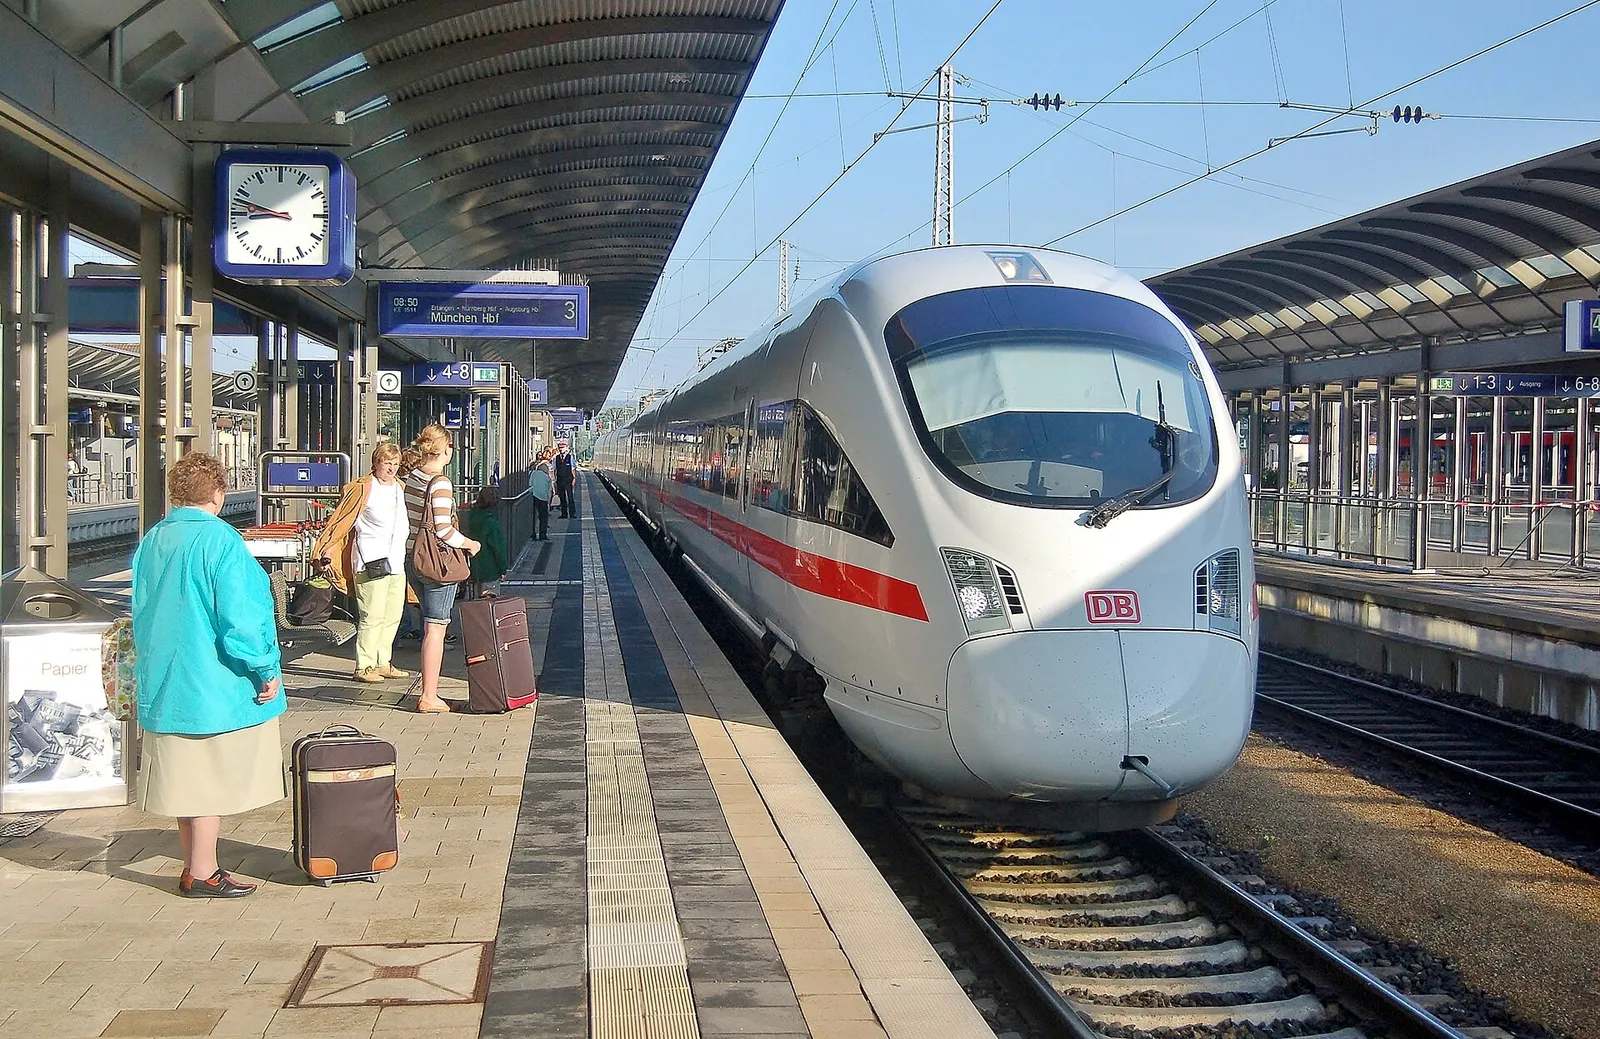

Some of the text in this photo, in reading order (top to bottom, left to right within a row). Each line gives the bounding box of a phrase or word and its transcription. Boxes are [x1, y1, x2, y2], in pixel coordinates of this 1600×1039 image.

[564, 300, 576, 319] 3
[431, 312, 500, 323] München Hbf
[442, 363, 470, 380] 4-8
[1473, 375, 1496, 390] 1-3
[1519, 380, 1542, 388] Ausgang
[1575, 376, 1600, 391] 6-8
[1091, 595, 1135, 618] DB
[41, 662, 90, 678] Papier
